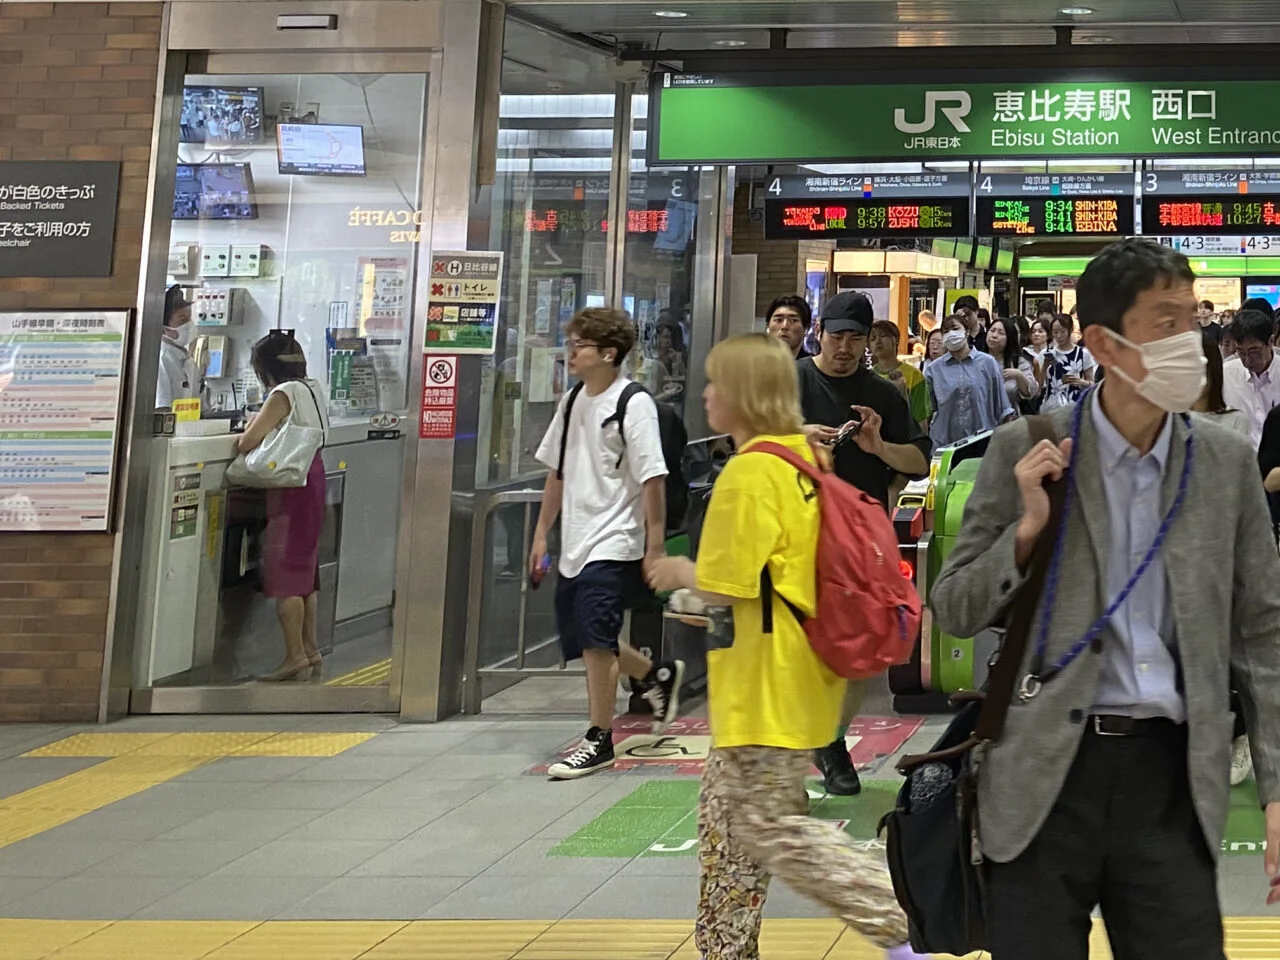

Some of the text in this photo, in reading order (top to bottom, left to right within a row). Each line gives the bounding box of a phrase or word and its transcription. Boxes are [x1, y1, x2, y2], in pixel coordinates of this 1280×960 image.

[992, 89, 1217, 122] 恵比寿駅 西口
[894, 91, 972, 133] JR
[991, 129, 1044, 146] Ebisu
[1052, 128, 1119, 146] Station
[1151, 128, 1201, 145] West
[904, 137, 961, 149] JR東日本
[768, 178, 782, 195] 4
[981, 176, 992, 192] 4
[1146, 174, 1157, 191] 3
[1045, 201, 1073, 211] 9:34
[1075, 201, 1117, 211] SHIN-KIBA
[1233, 203, 1262, 214] 9:45
[857, 208, 885, 217] 9:38
[1045, 212, 1072, 221] 9:41
[1075, 211, 1117, 221] SHIN-KIBA
[857, 218, 885, 228] 9:57
[888, 218, 919, 228] ZUSHI
[1227, 215, 1262, 225] 10:27
[1045, 222, 1073, 232] 9:44
[1075, 222, 1117, 232] EBINA
[450, 263, 460, 273] H
[464, 283, 487, 291] トイレ
[954, 649, 960, 658] 2
